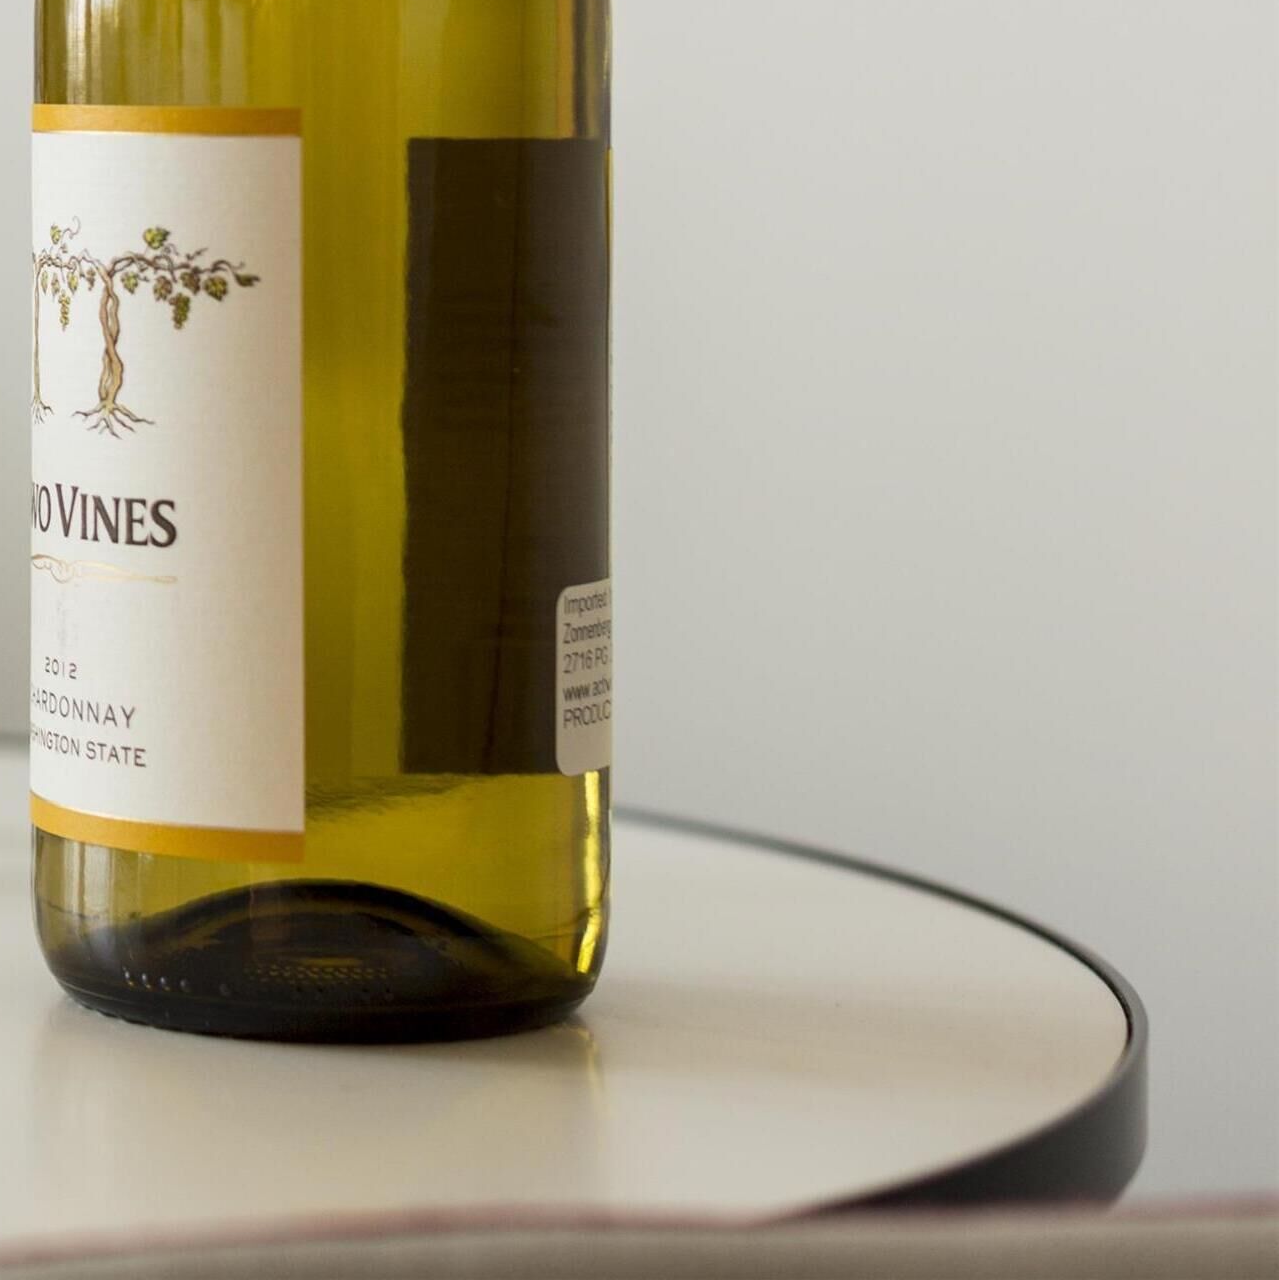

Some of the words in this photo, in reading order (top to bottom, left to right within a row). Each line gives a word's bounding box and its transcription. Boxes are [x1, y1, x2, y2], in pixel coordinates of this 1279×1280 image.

[44, 655, 78, 680] 2012
[562, 648, 592, 675] 2716
[85, 740, 147, 768] STATE
